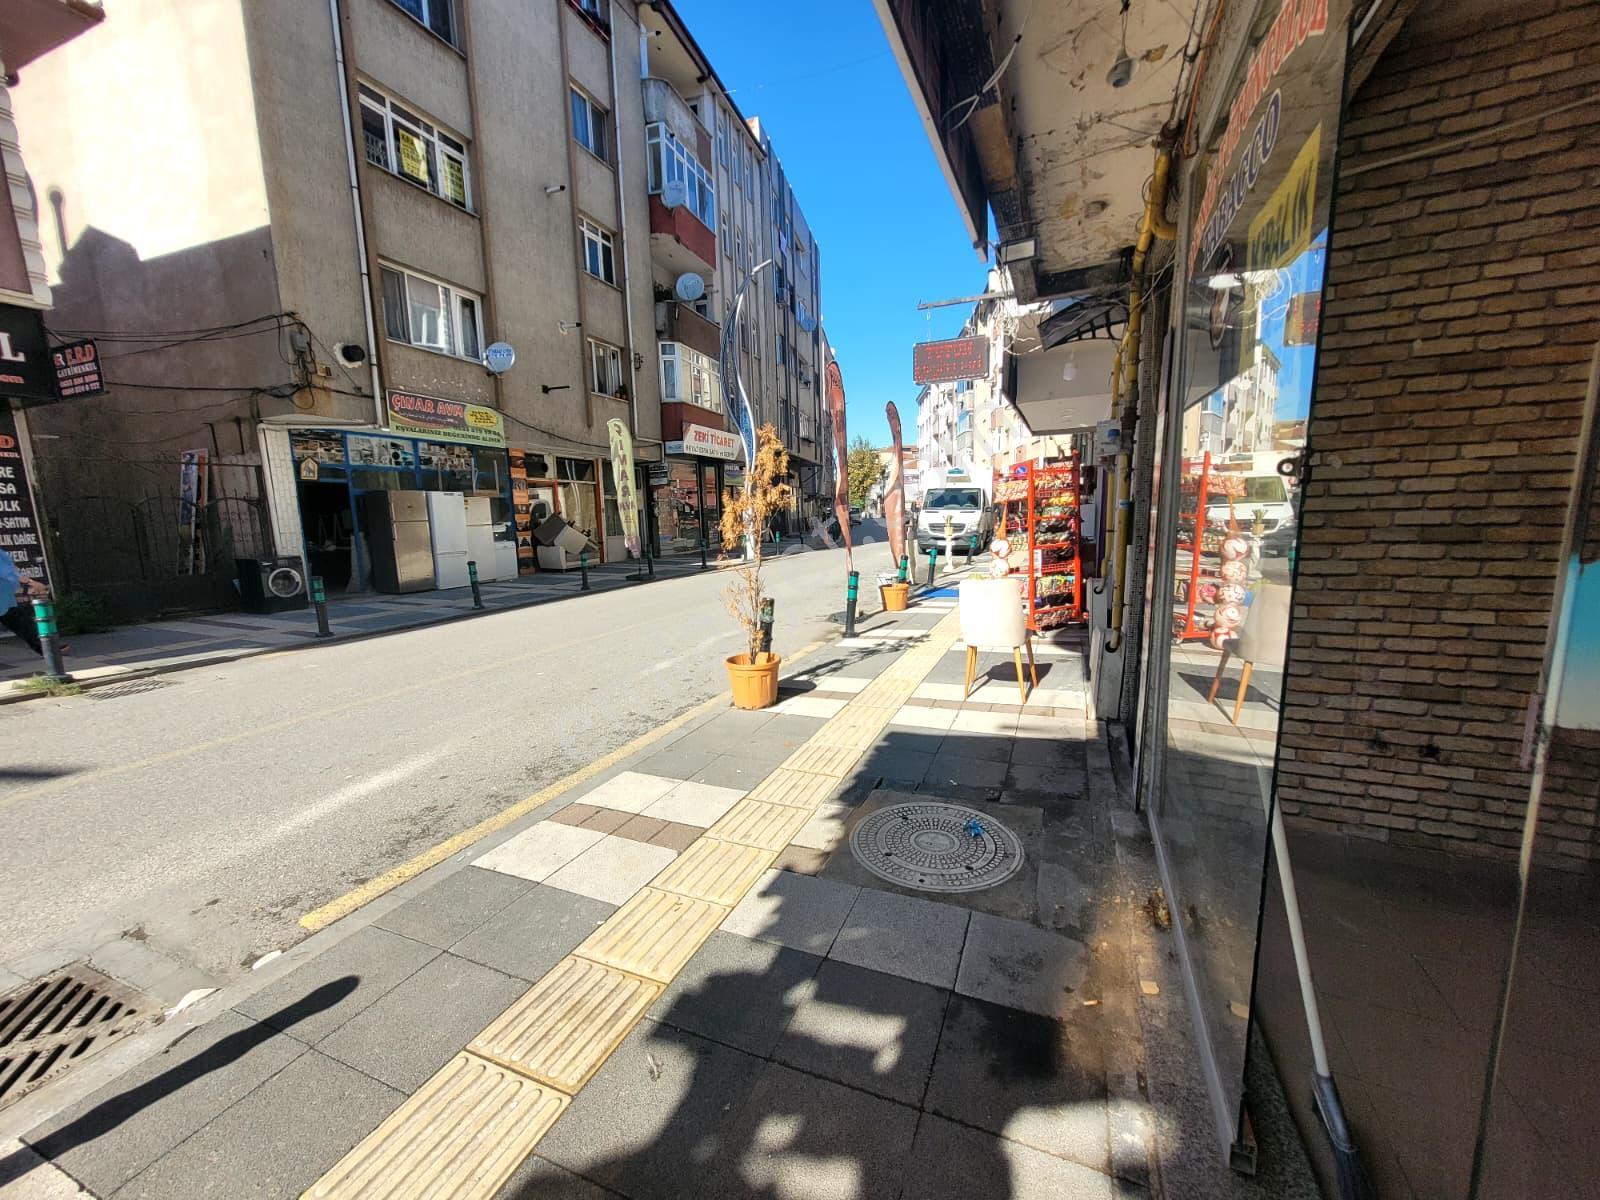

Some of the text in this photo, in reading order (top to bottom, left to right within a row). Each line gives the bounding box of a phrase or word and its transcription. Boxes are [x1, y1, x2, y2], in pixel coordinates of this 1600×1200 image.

[392, 394, 434, 412] ÇINAR
[694, 430, 735, 449] ZEKİ TİCARET
